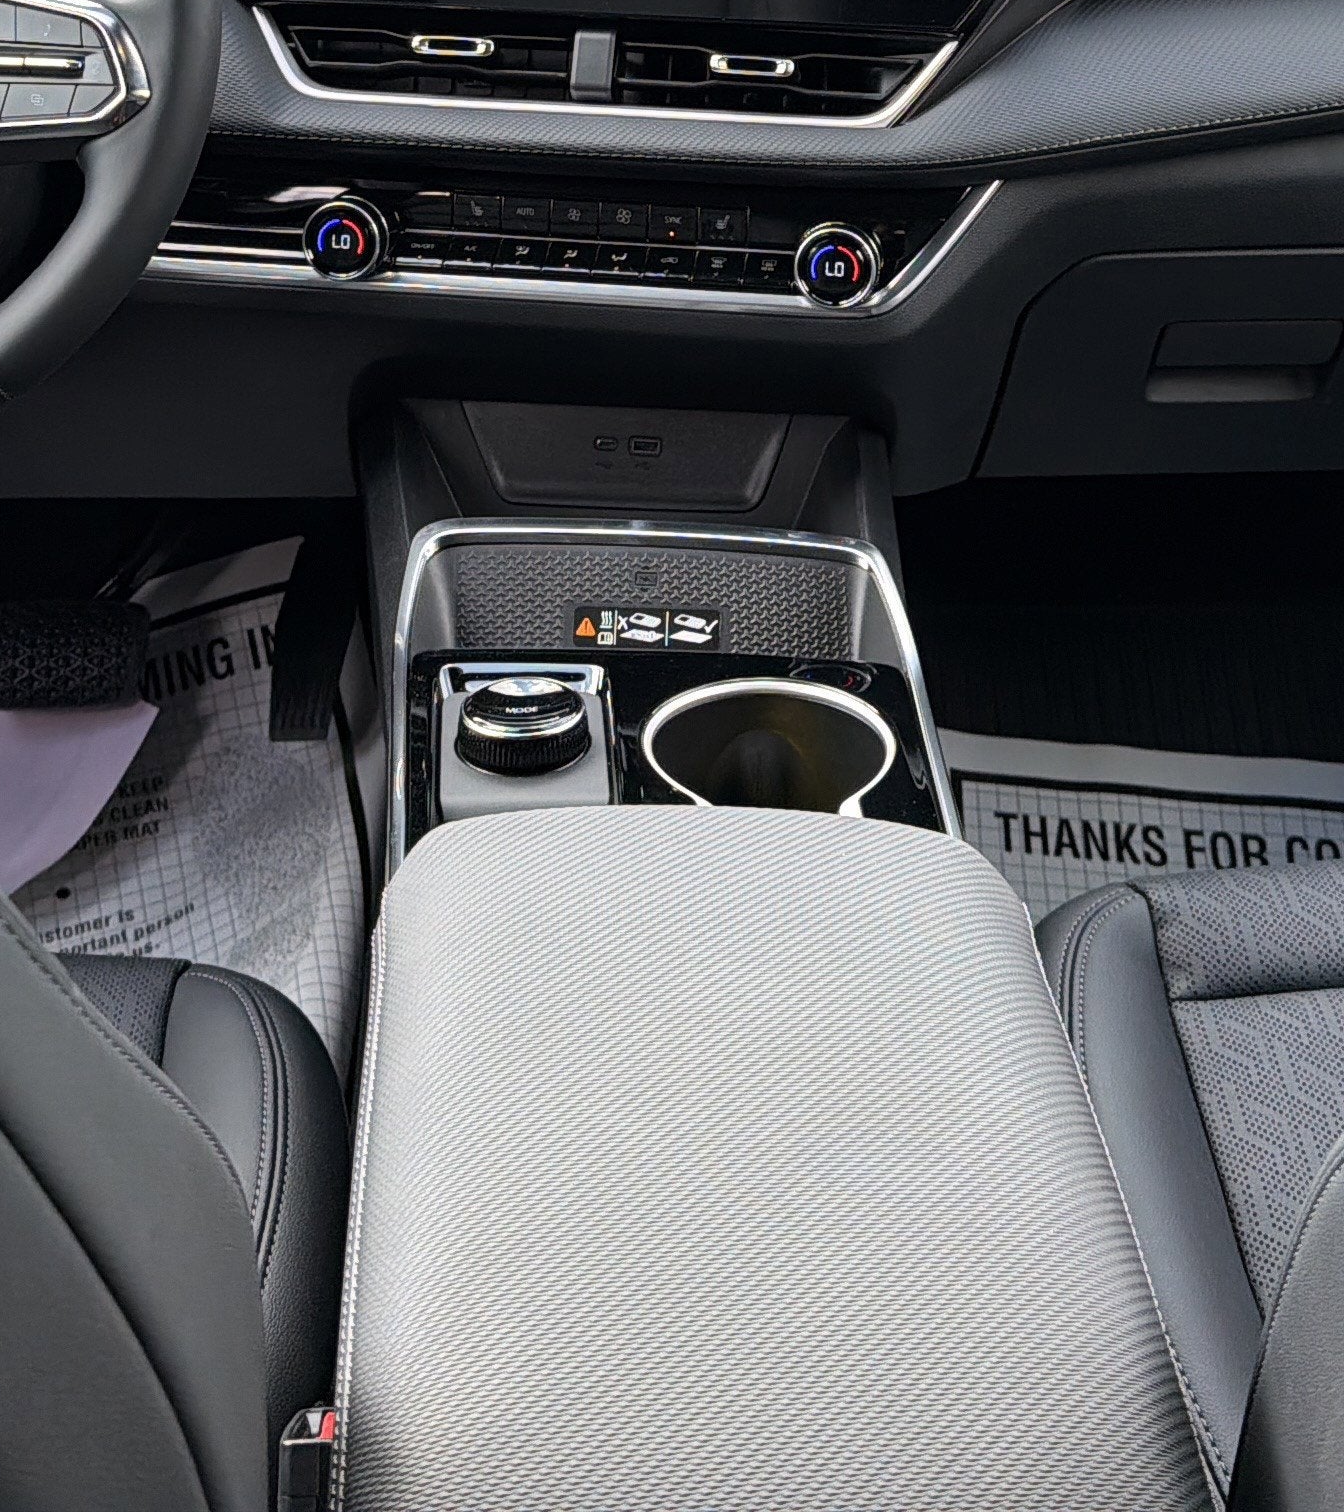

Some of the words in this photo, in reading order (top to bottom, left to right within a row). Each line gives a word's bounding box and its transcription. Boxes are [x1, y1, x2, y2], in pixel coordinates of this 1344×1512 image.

[516, 207, 535, 217] AUTO
[664, 216, 682, 225] SYNC
[138, 637, 235, 702] MING
[506, 706, 539, 714] MODE
[993, 810, 1169, 869] THANKS
[1182, 828, 1269, 870] FOR
[40, 914, 112, 943] stomer
[118, 909, 135, 923] is
[134, 902, 195, 942] person
